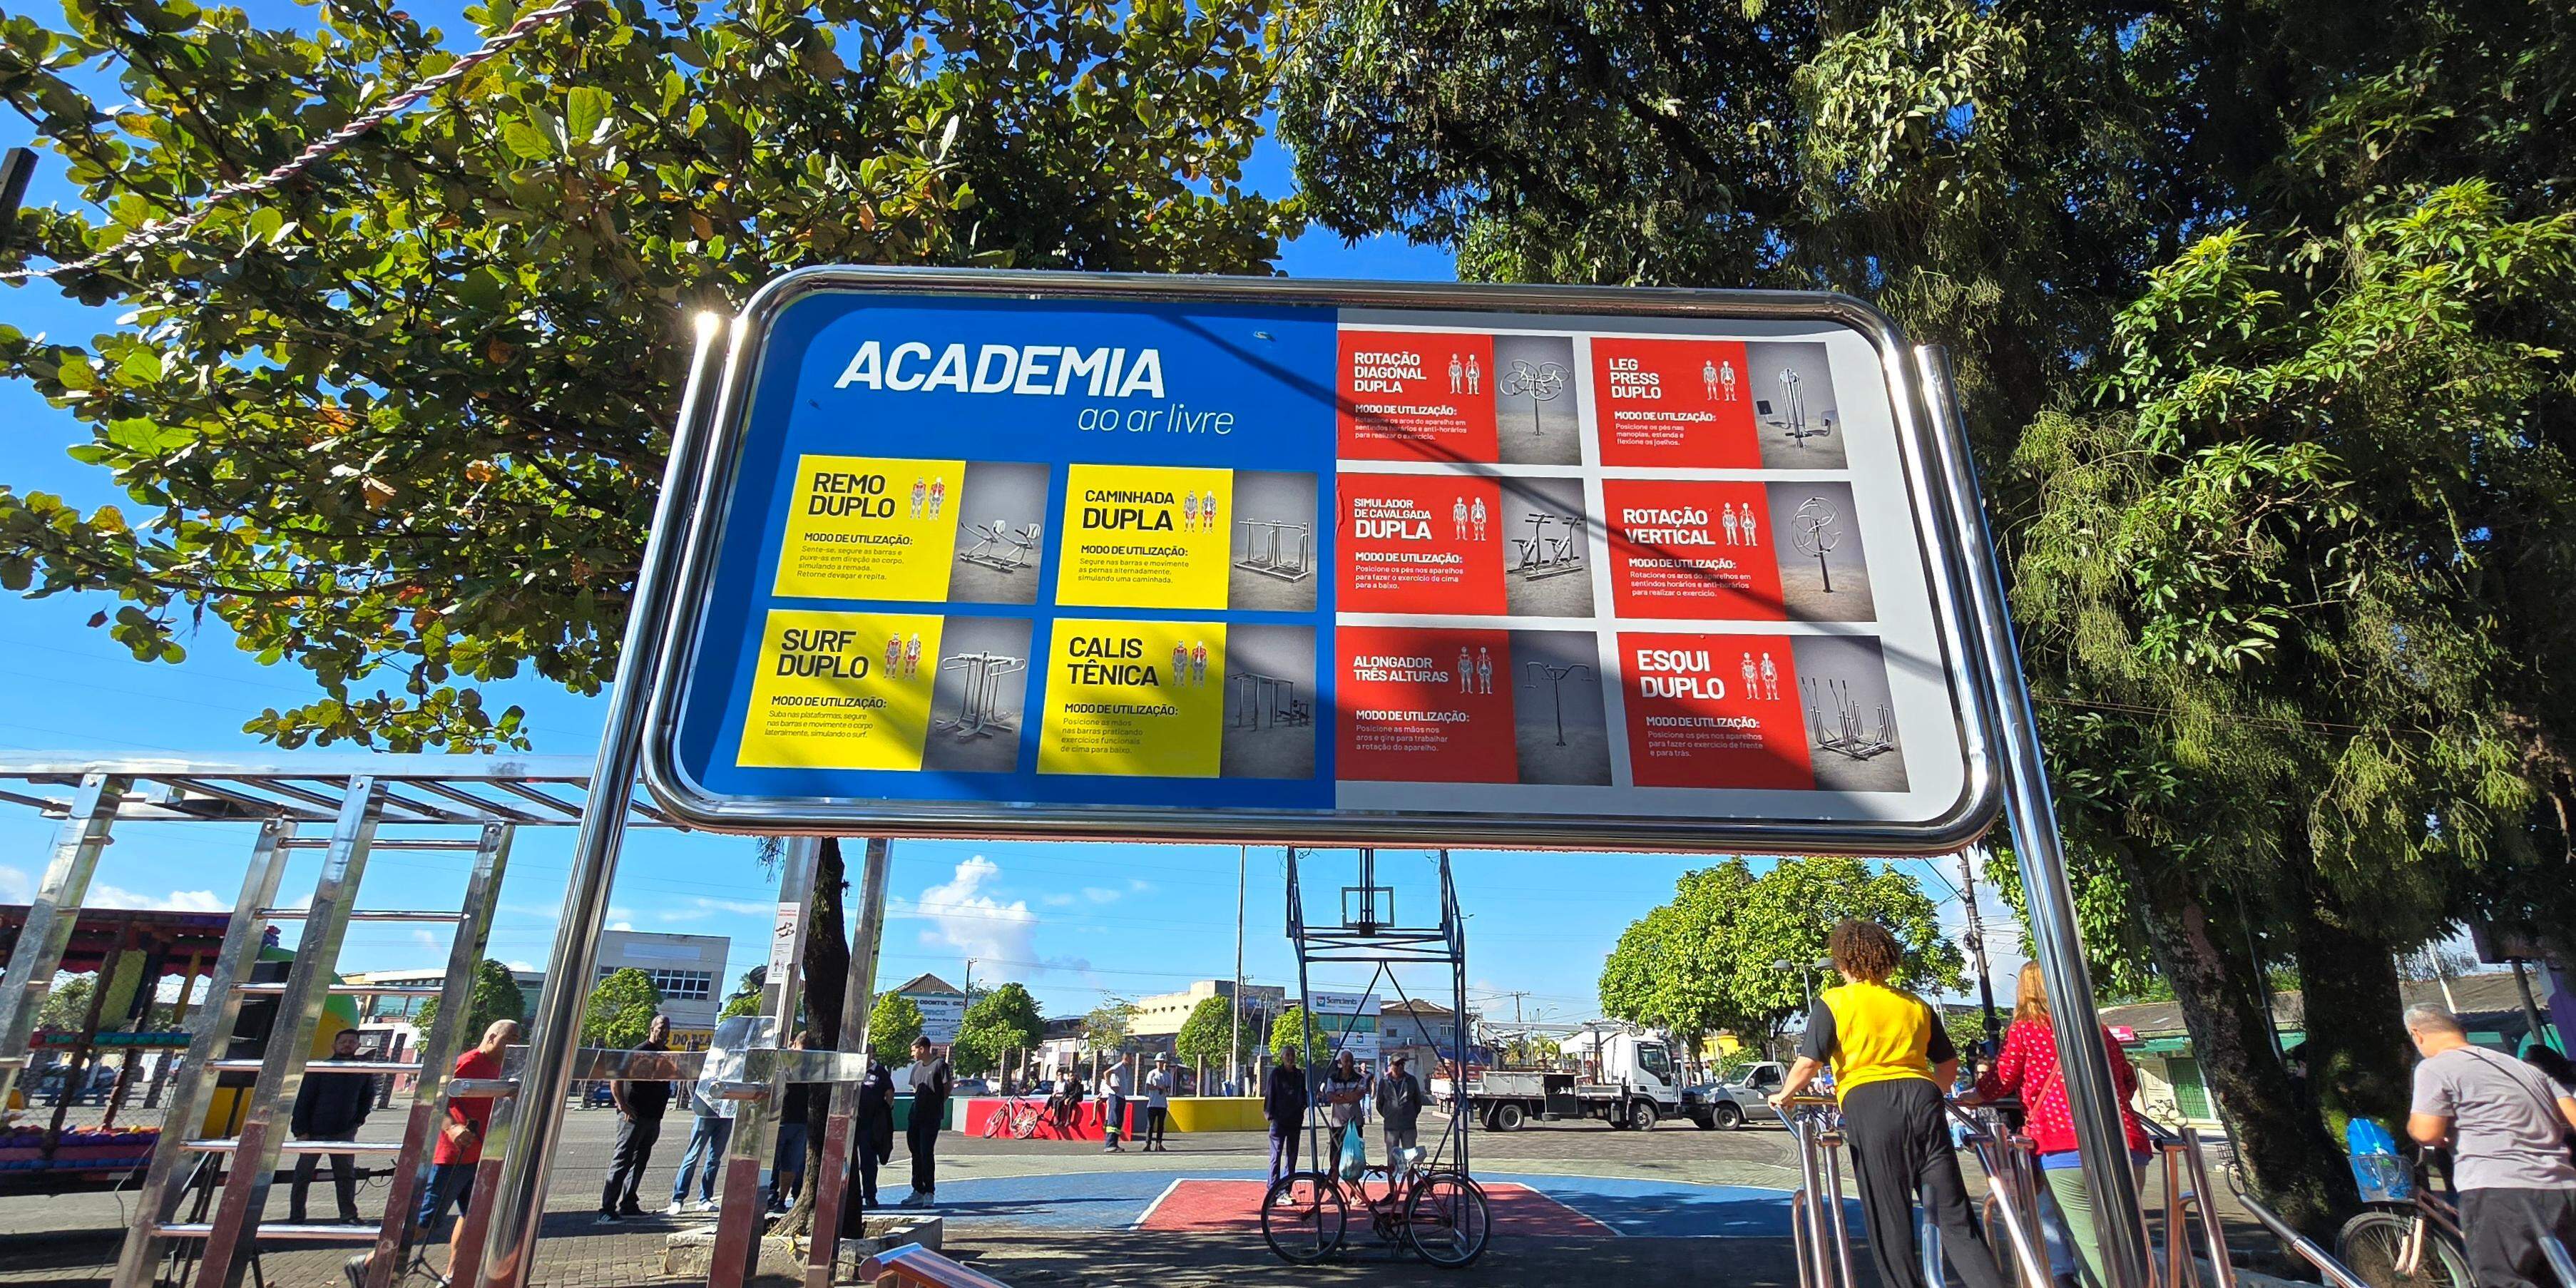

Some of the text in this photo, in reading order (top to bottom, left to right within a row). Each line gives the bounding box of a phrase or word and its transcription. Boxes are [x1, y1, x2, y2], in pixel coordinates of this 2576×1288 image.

[1354, 351, 1420, 367] ROTAÇÃO
[1609, 358, 1637, 371] LEG
[834, 340, 1165, 399] ACADEMIA
[1355, 366, 1426, 380] DIAGONAL
[1610, 372, 1659, 385] PRESS
[1355, 380, 1403, 393] DUPLA
[1612, 386, 1661, 399] DUPLO
[1356, 404, 1457, 416] MODO DE UTILIZAÇÃO:
[1615, 411, 1717, 423] MODO DE UTILIZAÇÃO:
[1078, 404, 1235, 435] ao ar livre
[812, 472, 885, 494] REMO
[1085, 490, 1175, 504] CAMINHADA
[1354, 499, 1414, 508] SIMULADOR
[807, 495, 895, 518] DUPLO
[1083, 508, 1173, 531] DUPLA
[1354, 508, 1431, 520] DE CAVALGADA
[1623, 506, 1708, 528] ROTAÇÃO
[1356, 520, 1432, 540] DUPLA
[1625, 528, 1716, 545] VERTICAL
[804, 533, 833, 542] MODO
[850, 534, 913, 546] UTILIZAÇÃO:
[1081, 545, 1187, 558] MODO DE UTILIZAÇÃO:
[1356, 552, 1462, 565] MODO DE UTILIZAÇÃO:
[1629, 558, 1737, 570] MODO DE UTILIZAÇÃO:
[781, 629, 857, 653] SURF
[1069, 637, 1143, 658] CALIS
[776, 654, 869, 678] DUPLO
[1354, 656, 1432, 668] ALONGADOR
[1637, 650, 1710, 673] ESQUI
[1068, 659, 1159, 686] TÊNICA
[1354, 668, 1448, 683] TRÊS ALTURAS
[1640, 677, 1724, 700] DUPLO
[772, 696, 886, 709] MODO DE UTILIZAÇÃO:
[1065, 703, 1178, 716] MODO DE UTILIZAÇÃO:
[1356, 710, 1470, 724] MODO DE UTILIZAÇÃO:
[1647, 716, 1760, 730] MODO DE UTILIZAÇÃO:
